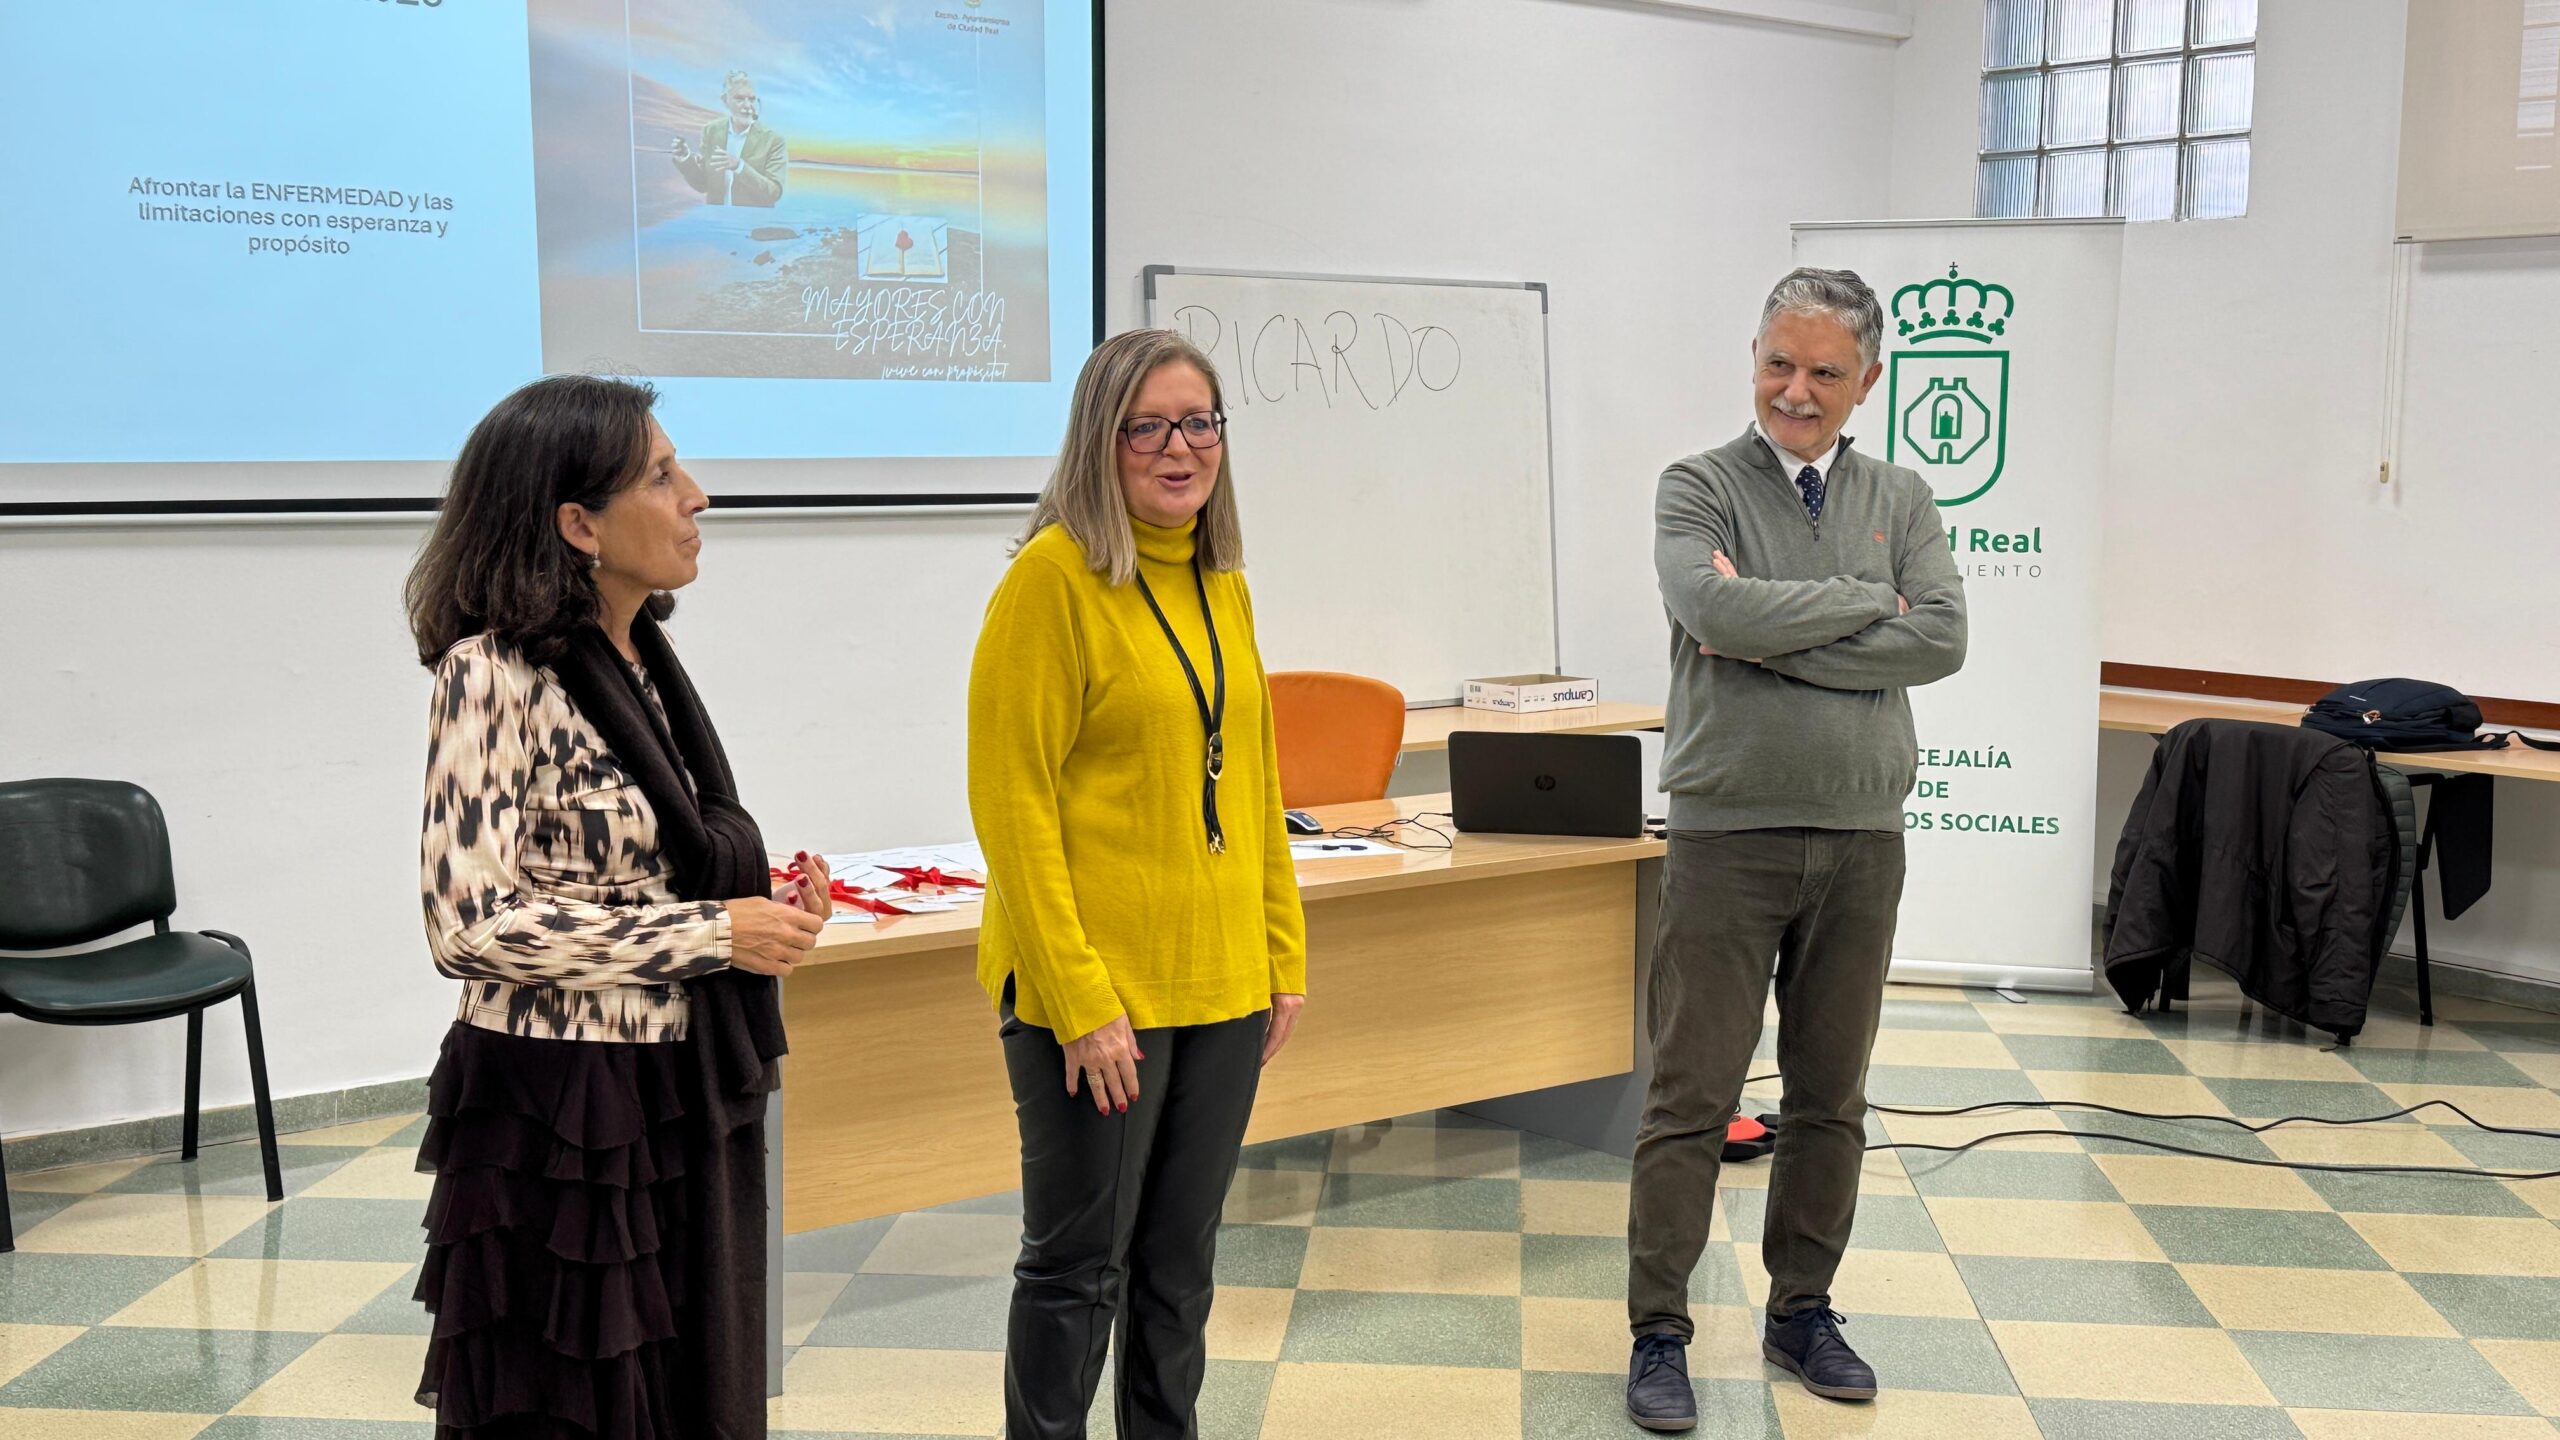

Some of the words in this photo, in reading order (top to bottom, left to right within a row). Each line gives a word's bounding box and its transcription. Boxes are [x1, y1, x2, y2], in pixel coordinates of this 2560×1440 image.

[128, 177, 221, 198] Afrontar
[226, 182, 246, 199] la
[252, 183, 404, 208] ENFERMEDAD
[408, 195, 419, 213] y
[424, 193, 454, 211] las
[139, 203, 275, 225] limitaciones
[281, 212, 320, 228] con
[326, 215, 432, 234] esperanza
[436, 220, 449, 238] y
[249, 235, 351, 256] propósito
[801, 286, 947, 326] MAYORES
[952, 291, 1005, 328] CON
[1174, 305, 1461, 410] RICARDO
[1970, 526, 2042, 554] Real
[1553, 688, 1594, 702] Campus
[1918, 745, 2012, 769] CEJALÍA
[1917, 780, 1949, 799] DE
[1940, 813, 2060, 835] SOCIALES
